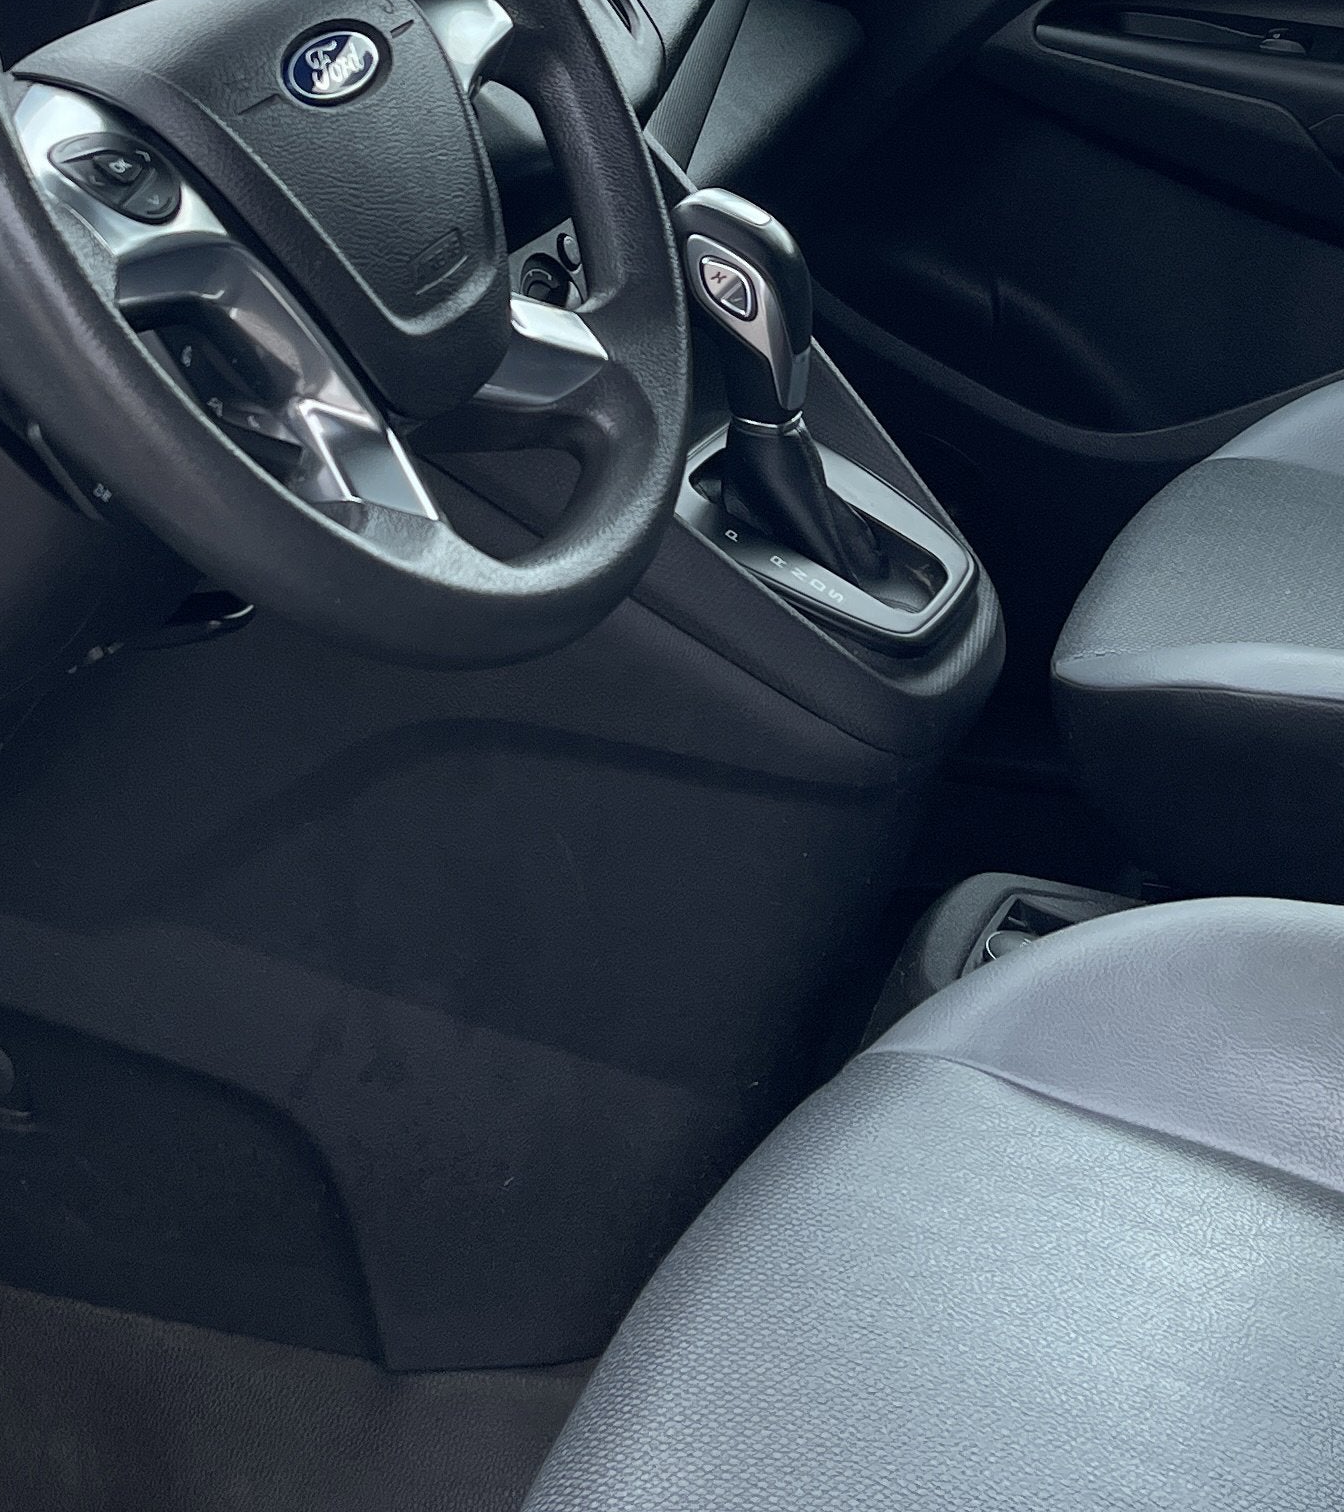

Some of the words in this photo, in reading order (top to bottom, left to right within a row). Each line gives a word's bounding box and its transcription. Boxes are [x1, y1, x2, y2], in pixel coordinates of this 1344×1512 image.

[108, 157, 133, 174] OK
[725, 529, 739, 543] P
[770, 555, 787, 568] R
[791, 567, 809, 581] N
[810, 579, 826, 593] D
[828, 589, 844, 603] S
